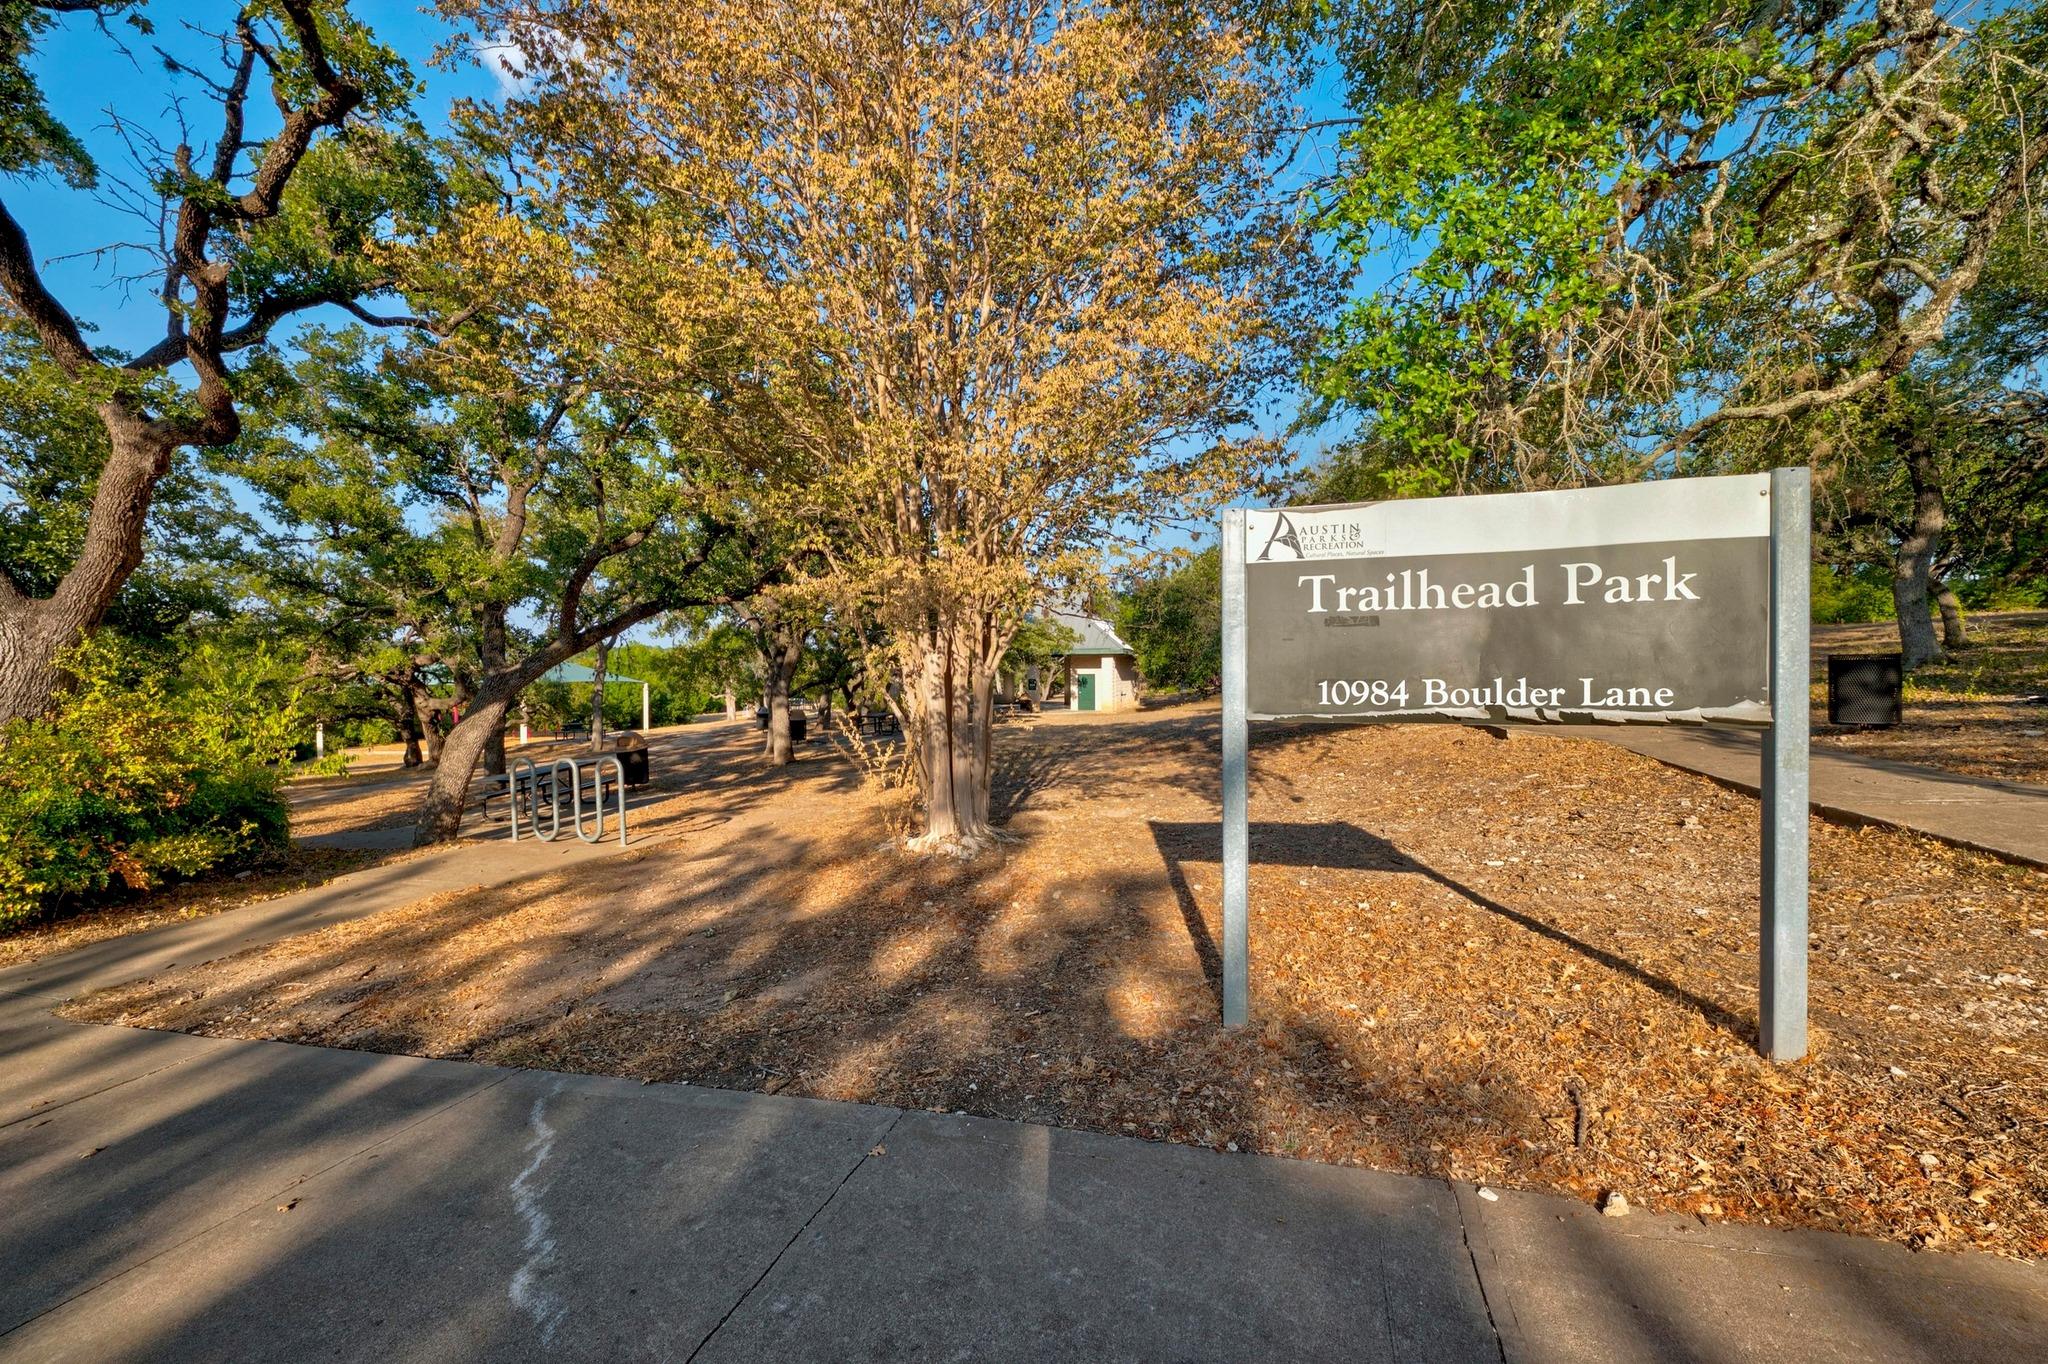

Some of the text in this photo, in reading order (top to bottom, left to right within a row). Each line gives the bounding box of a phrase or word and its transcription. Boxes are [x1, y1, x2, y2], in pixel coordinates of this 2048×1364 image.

[1299, 522, 1361, 536] AUSTIN
[1301, 529, 1361, 544] PARKS &
[1303, 540, 1364, 551] RECREATION
[1298, 555, 1701, 613] Trailhead Park
[1318, 677, 1674, 707] 10984 Boulder Lane
